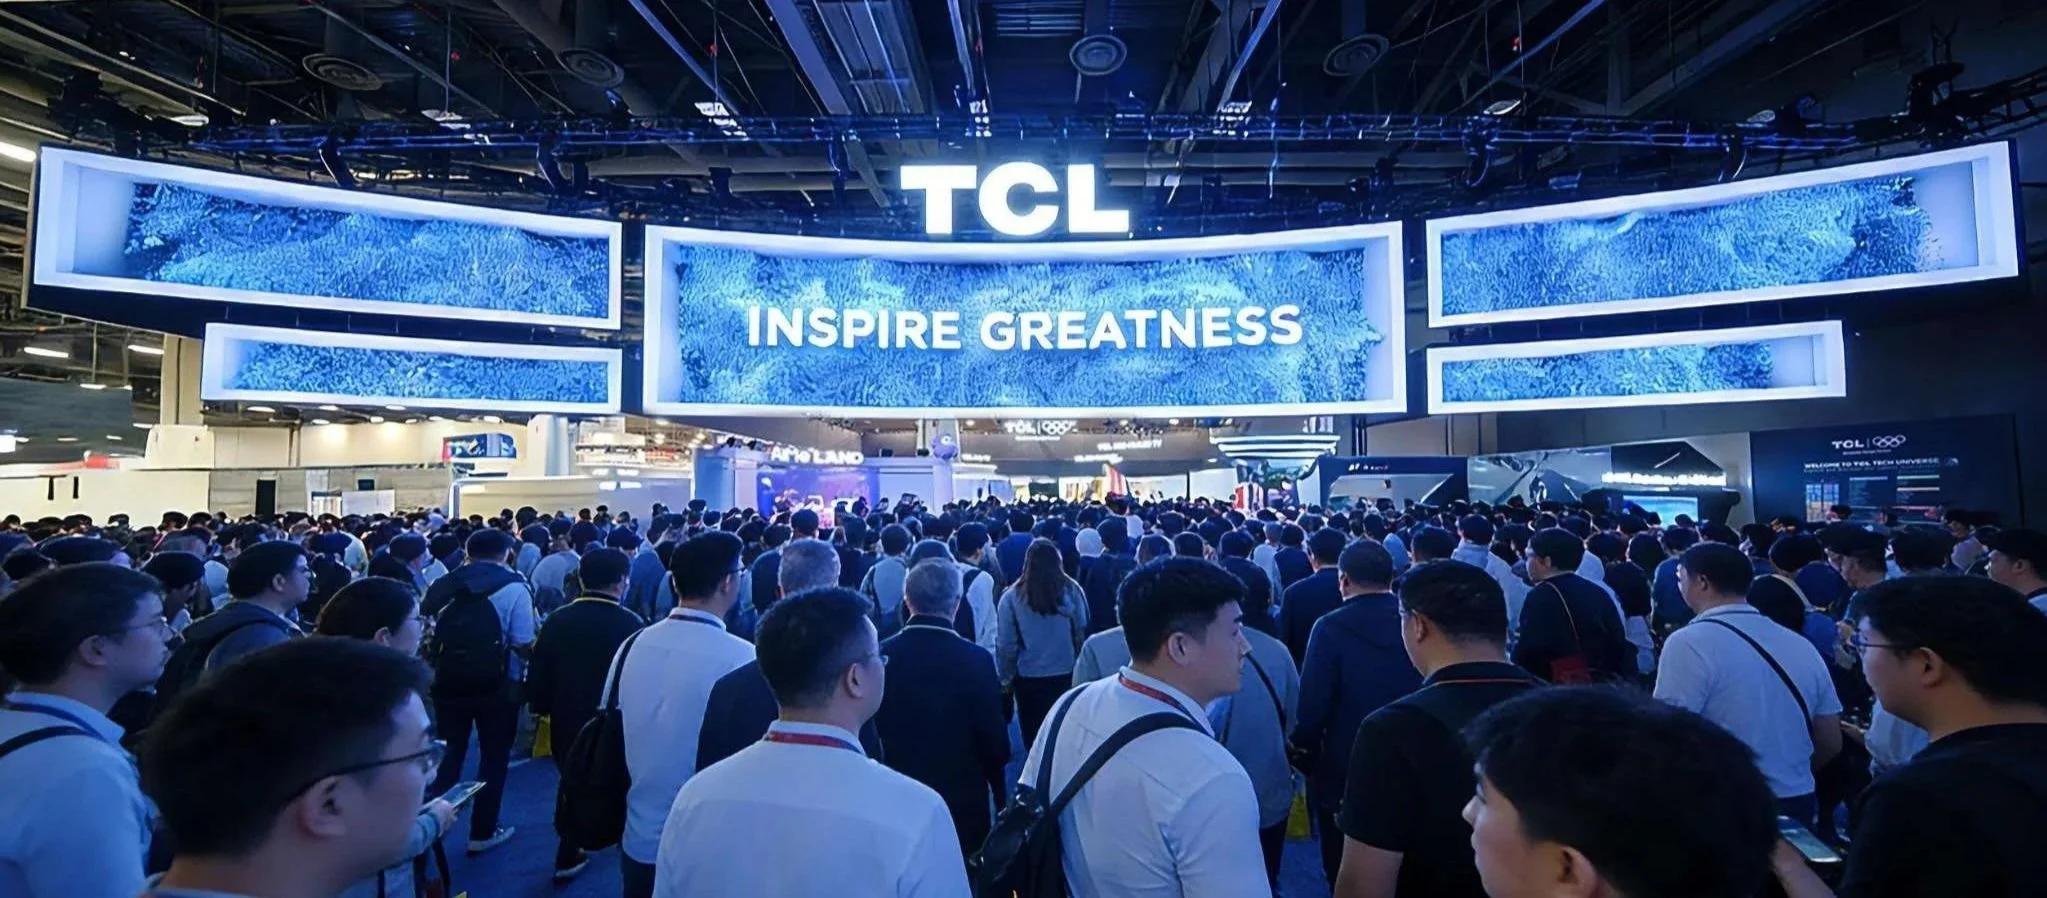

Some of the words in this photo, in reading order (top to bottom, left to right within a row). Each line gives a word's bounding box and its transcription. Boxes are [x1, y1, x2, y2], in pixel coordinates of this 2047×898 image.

[900, 162, 1131, 236] TCL
[748, 305, 962, 349] INSPIRE
[979, 304, 1303, 350] GREATNESS
[1832, 440, 1864, 449] TCL
[813, 449, 865, 465] LAND
[1872, 458, 1895, 466] TECH
